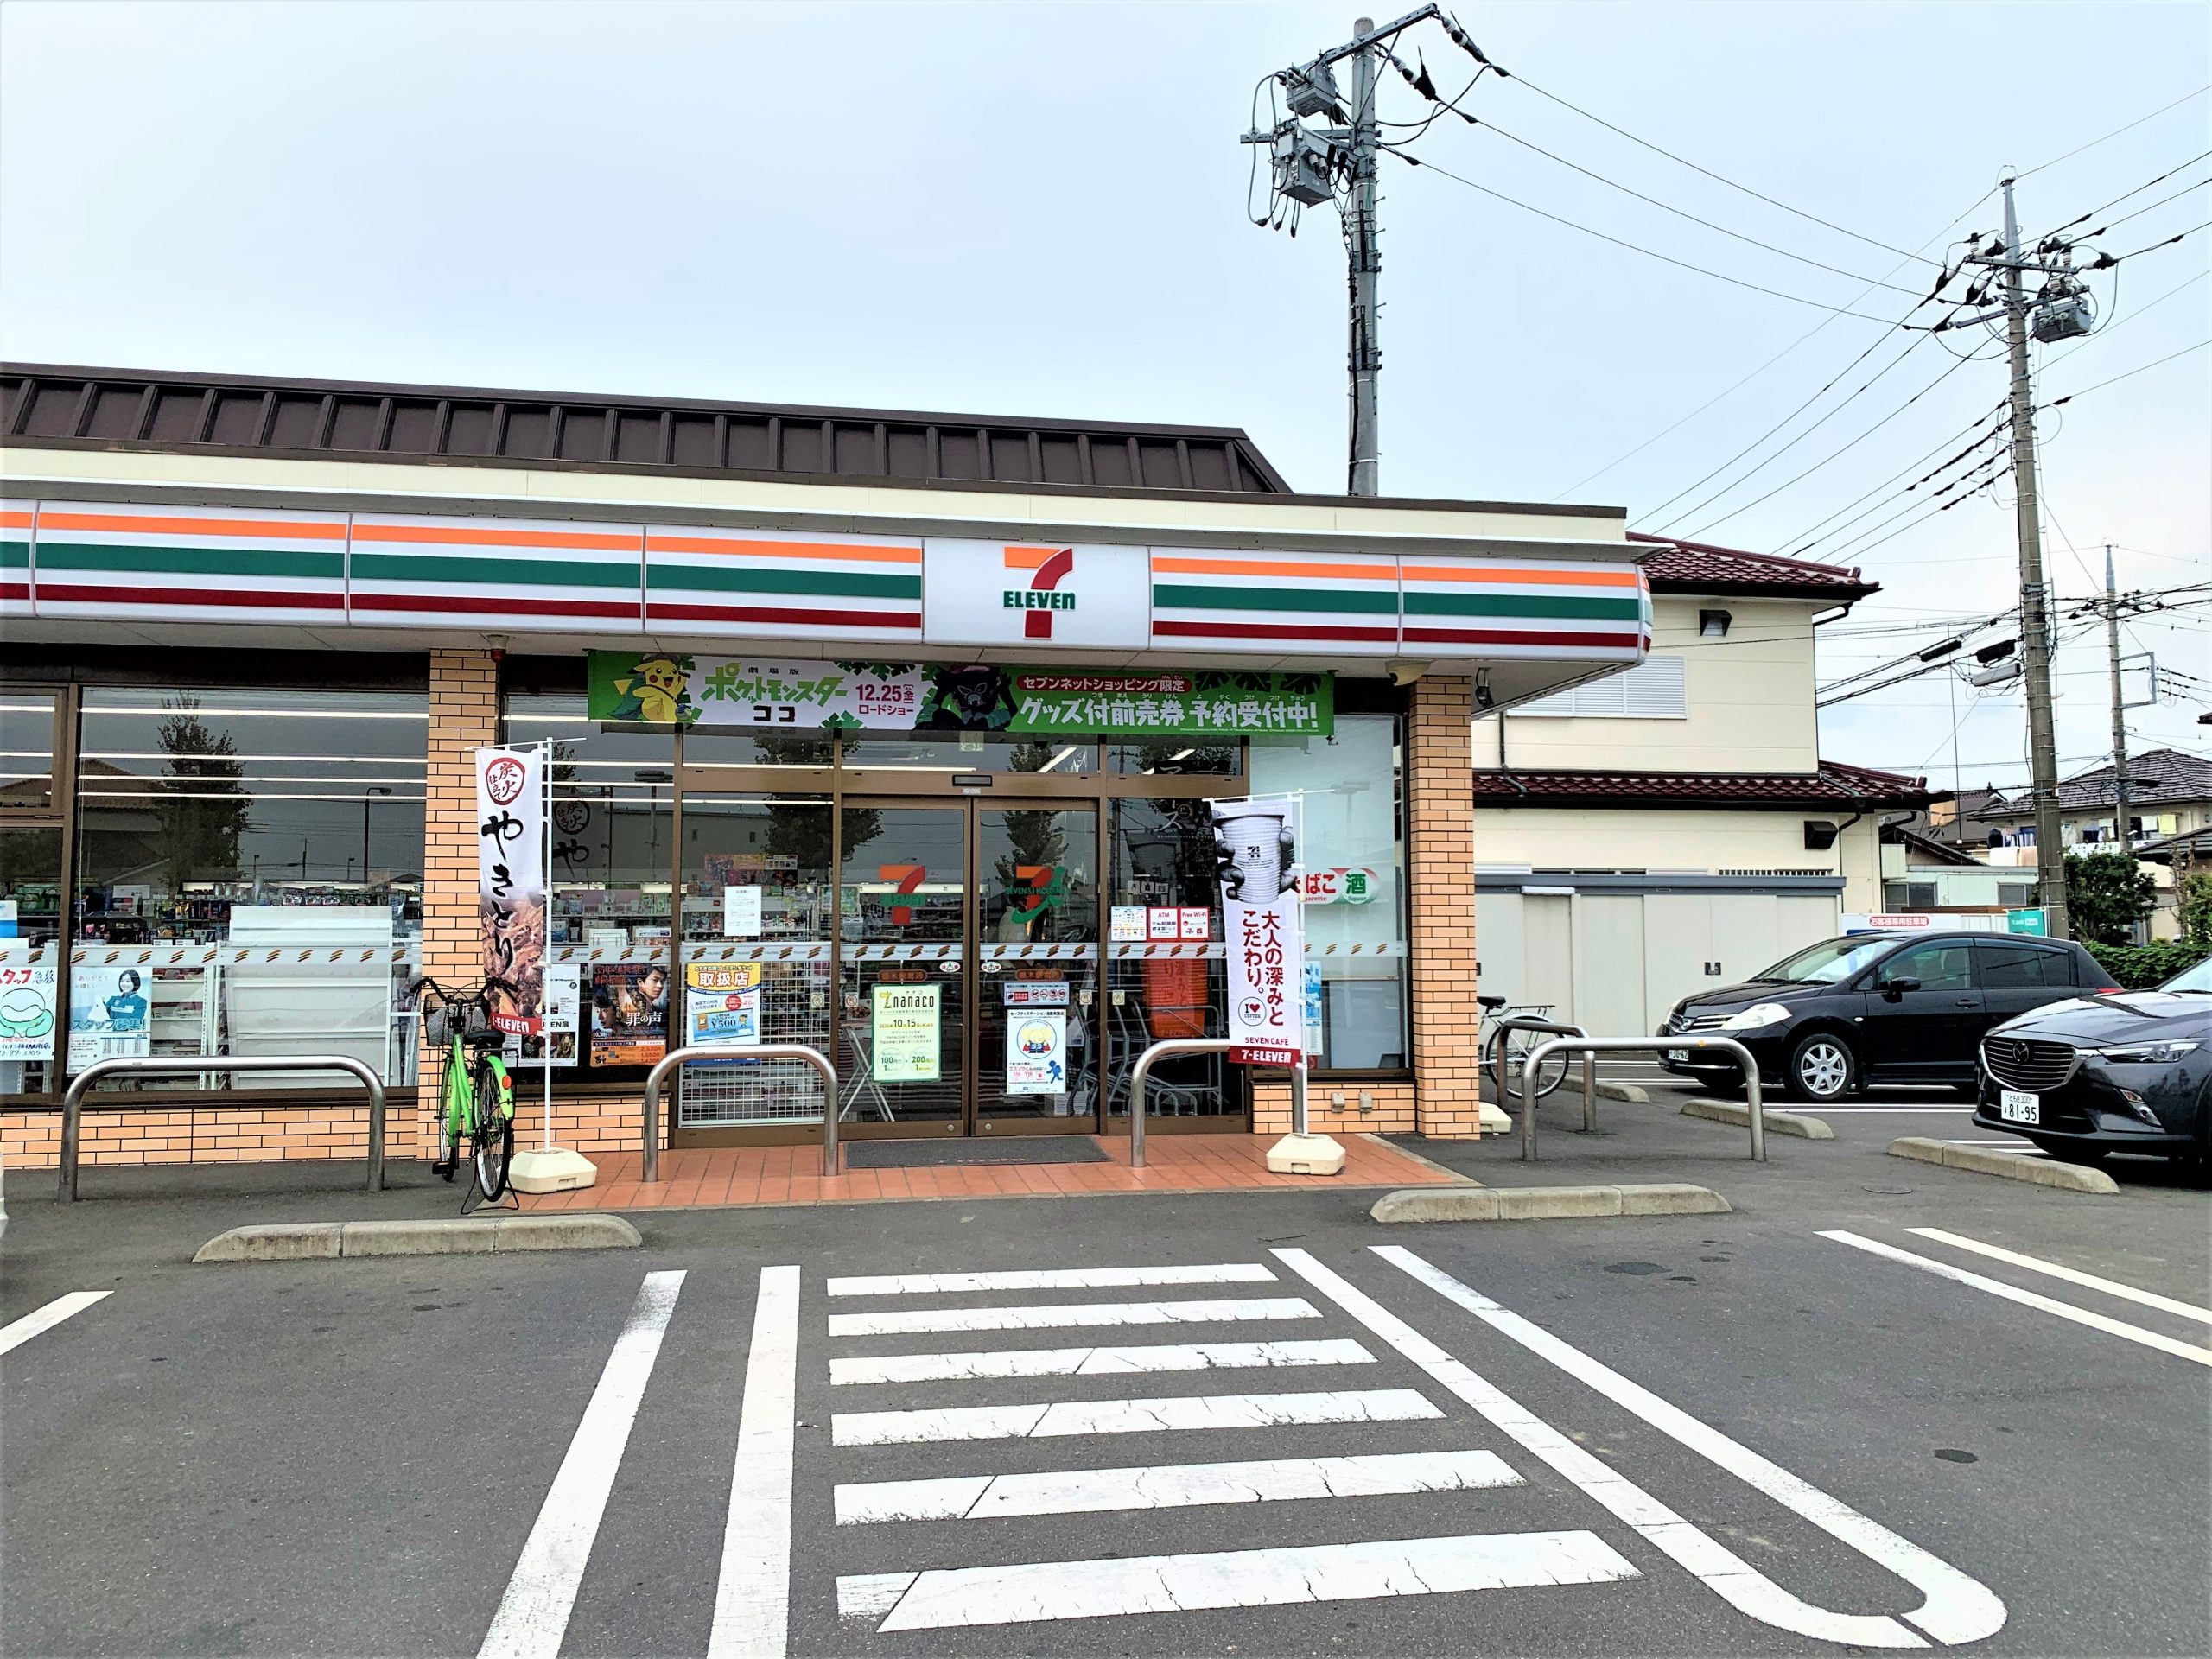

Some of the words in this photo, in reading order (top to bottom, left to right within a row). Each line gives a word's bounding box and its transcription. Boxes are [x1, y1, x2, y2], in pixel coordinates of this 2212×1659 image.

[1004, 546, 1073, 639] 7
[700, 662, 849, 707] ポケットモンスター
[1023, 677, 1185, 692] セブンネットショッピング限定
[753, 705, 796, 722] ココ
[859, 704, 914, 716] ロードショー
[1020, 696, 1185, 727] グッズ付前売券
[481, 810, 524, 976] やきとり
[1345, 873, 1367, 894] 酒
[1243, 909, 1264, 994] こだわり。
[1261, 910, 1284, 1027] 大人の深みと
[699, 971, 749, 987] 取扱店
[893, 995, 934, 1008] nanaco
[626, 1011, 664, 1027] 罪の声
[1244, 1036, 1269, 1045] SEVEN
[1270, 1036, 1289, 1046] CAFÉ
[2009, 1103, 2037, 1122] 81-95
